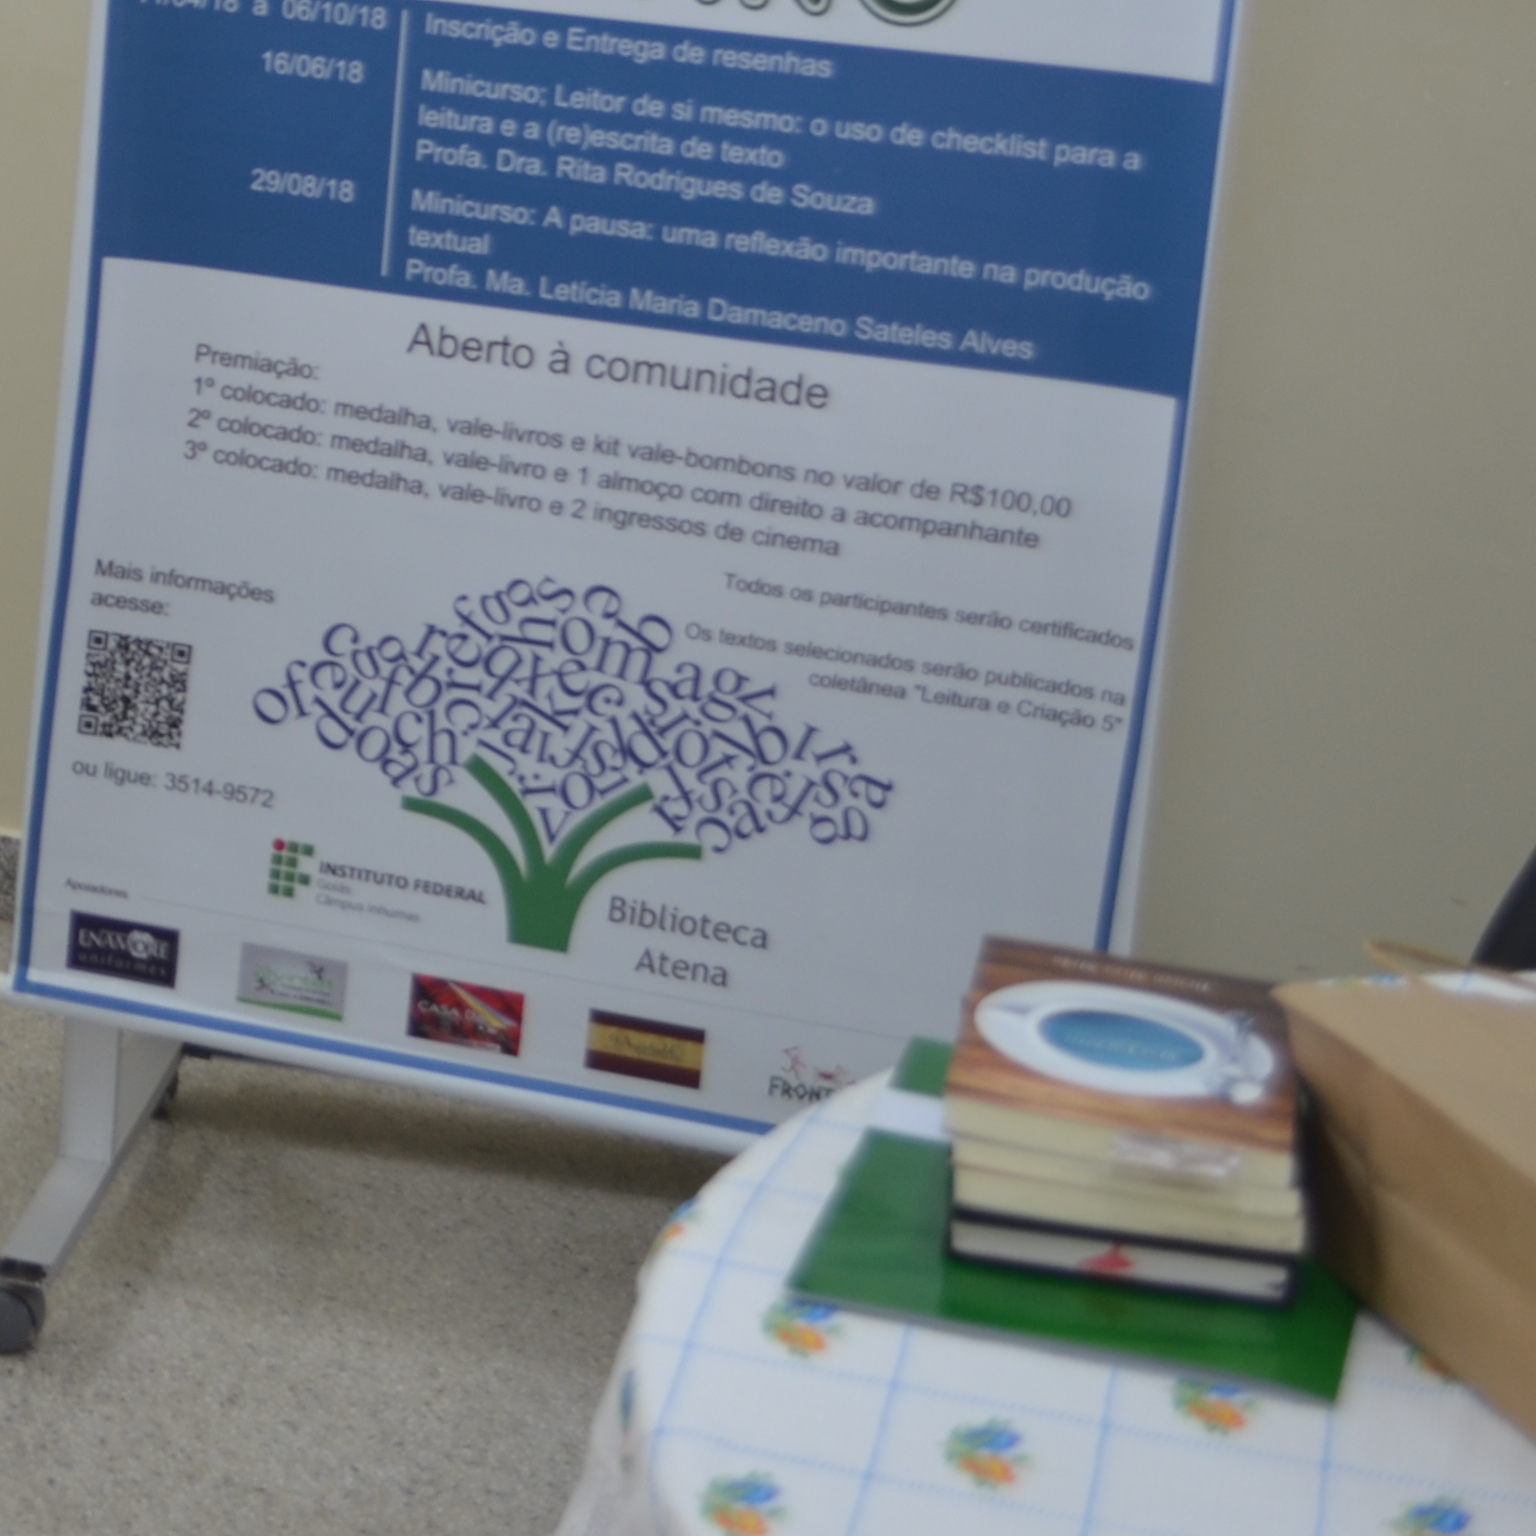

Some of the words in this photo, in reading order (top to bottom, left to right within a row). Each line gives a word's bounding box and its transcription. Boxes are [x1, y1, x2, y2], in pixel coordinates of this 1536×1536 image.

[261, 50, 365, 84] 16/06/18
[425, 12, 537, 47] Inscrição
[542, 31, 559, 49] e
[566, 26, 666, 64] Entrega
[672, 40, 706, 65] de
[711, 47, 834, 79] resenhas
[417, 104, 494, 136] leitura
[499, 119, 517, 138] e
[522, 121, 540, 140] a
[546, 118, 675, 157] (re)escrita
[680, 136, 714, 162] de
[720, 139, 786, 169] texto
[554, 84, 627, 114] Leitor
[632, 93, 665, 119] de
[671, 98, 694, 123] si
[699, 105, 804, 134] mesmo:
[809, 117, 829, 137] o
[834, 120, 884, 144] uso
[889, 122, 925, 148] de
[930, 127, 1049, 162] checklist
[1053, 143, 1116, 169] para
[1121, 151, 1142, 172] a
[249, 167, 355, 203] 29/08/18
[415, 138, 487, 170] Profa.
[495, 148, 547, 177] Dra.
[555, 156, 607, 185] Rita
[613, 162, 745, 202] Rodrigues
[749, 180, 784, 206] de
[790, 183, 876, 216] Souza
[407, 224, 492, 256] textual
[410, 188, 536, 226] Minicurso:
[542, 205, 564, 230] A
[569, 213, 655, 241] pausa:
[660, 224, 718, 250] uma
[724, 229, 829, 262] reflexão
[834, 240, 976, 280] importante
[982, 262, 1017, 285] na
[1023, 265, 1152, 302] produção
[404, 257, 476, 290] Profa.
[484, 268, 530, 297] Ma.
[538, 275, 623, 309] Letícia
[628, 286, 701, 319] Maria
[706, 296, 848, 337] Damaceno
[854, 314, 953, 351] Sateles
[958, 328, 1035, 360] Alves
[194, 342, 321, 380] Premiação:
[405, 321, 535, 370] Aberto
[547, 340, 571, 376] à
[584, 352, 831, 410] comunidade
[215, 414, 322, 448] colocado:
[329, 431, 434, 467] medalha,
[441, 449, 547, 481] vale-livro
[552, 466, 569, 484] e
[596, 470, 684, 503] almoço
[690, 485, 743, 508] com
[748, 491, 824, 521] direito
[830, 505, 847, 524] a
[853, 506, 1040, 550] acompanhante
[220, 383, 327, 415] colocado:
[333, 400, 438, 434] medalha,
[445, 416, 564, 450] vale-livros
[570, 435, 586, 453] e
[592, 433, 620, 457] kit
[627, 439, 796, 483] vale-bombons
[802, 467, 835, 488] no
[841, 471, 904, 496] valor
[909, 479, 942, 503] de
[948, 482, 1074, 520] R$100,00
[212, 446, 319, 479] colocado:
[325, 464, 430, 499] medalha,
[437, 482, 543, 513] vale-livro
[548, 499, 564, 516] e
[569, 497, 588, 520] 2
[591, 500, 708, 538] ingressos
[713, 519, 745, 544] de
[751, 525, 841, 558] cinema
[89, 590, 170, 617] acesse:
[93, 558, 144, 582] Mais
[149, 565, 276, 605] informações
[723, 572, 784, 599] Todos
[789, 586, 814, 603] os
[818, 590, 949, 622] participantes
[954, 608, 1013, 631] serão
[1017, 618, 1135, 652] certificados
[684, 621, 713, 642] Os
[718, 627, 778, 653] textos
[783, 640, 916, 673] selecionados
[921, 659, 978, 682] serão
[983, 668, 1095, 701] publicados
[1100, 689, 1127, 708] na
[807, 671, 907, 700] coletânea
[913, 682, 991, 712] "Leitura
[996, 699, 1011, 715] e
[1015, 698, 1096, 729] Criação
[71, 760, 98, 777] ou
[103, 760, 157, 787] ligue:
[163, 772, 276, 809] 3514-9572
[319, 861, 409, 891] INSTITUTO
[412, 878, 488, 905] FEDERAL
[606, 895, 770, 950] Biblioteca
[634, 948, 730, 988] Atena
